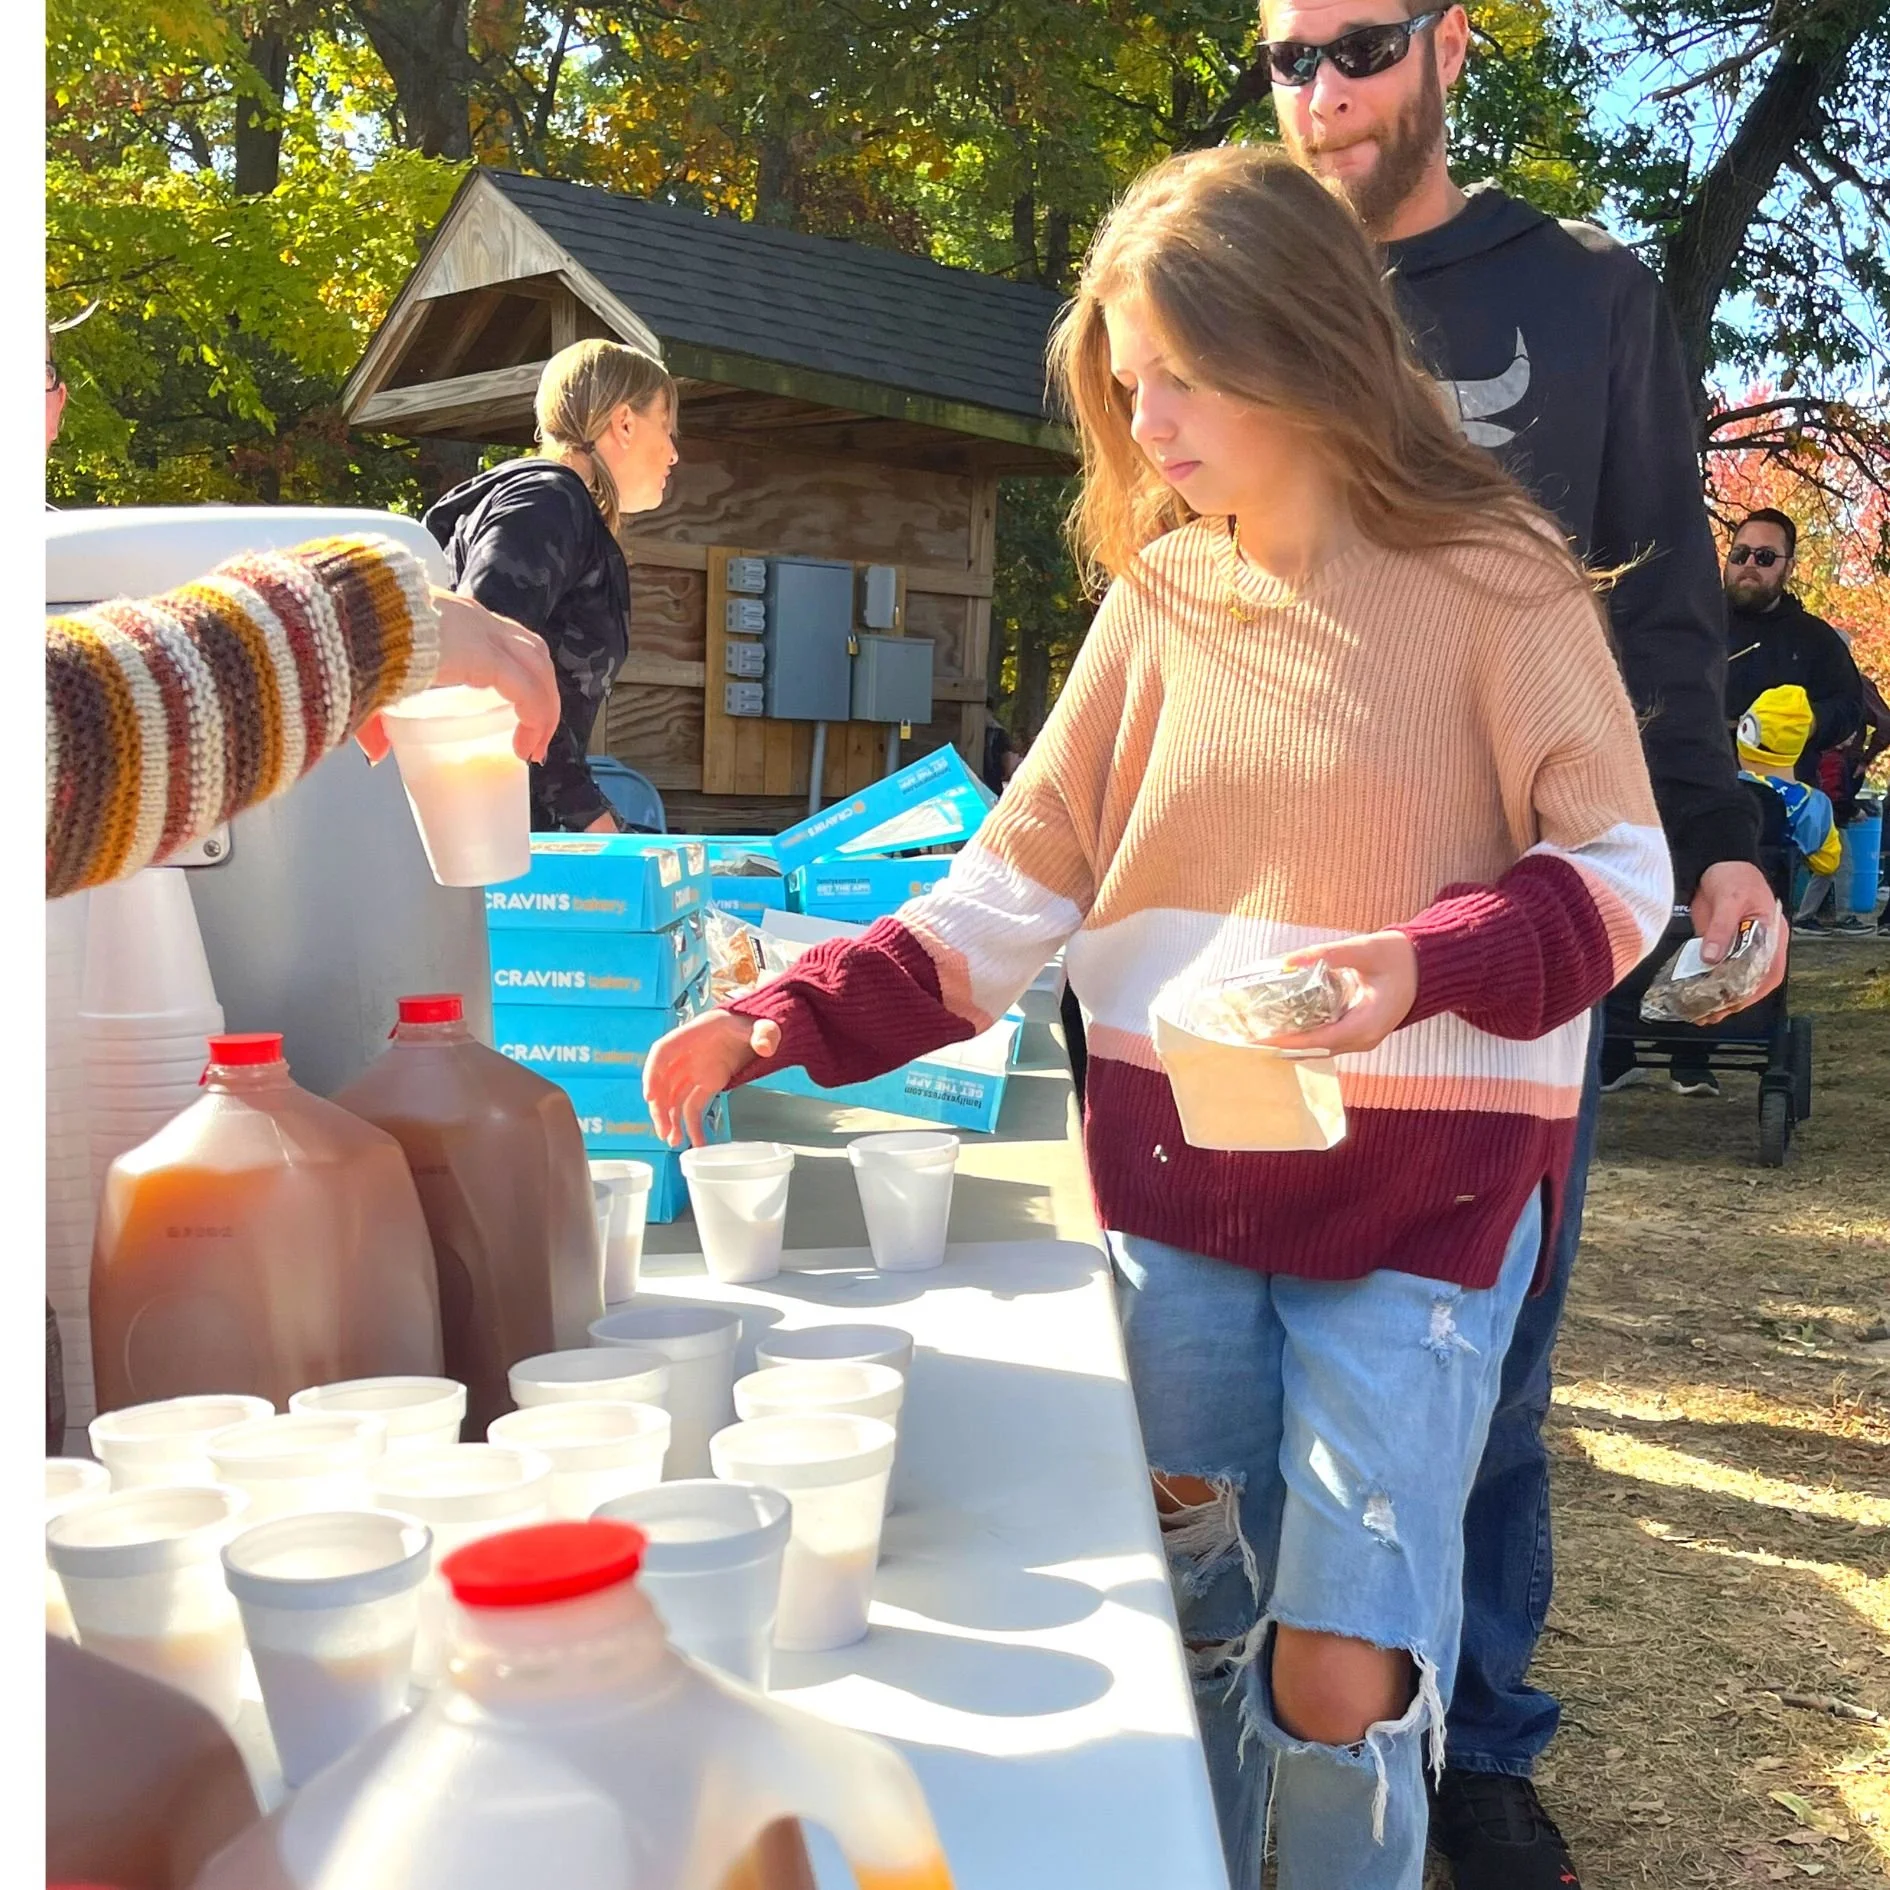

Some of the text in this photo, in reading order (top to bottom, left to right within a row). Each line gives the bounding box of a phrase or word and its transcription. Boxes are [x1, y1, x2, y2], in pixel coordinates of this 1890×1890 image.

[711, 900, 740, 910] VIN'S
[494, 969, 585, 989] CRAVIN'S
[500, 1044, 591, 1063] CRAVIN'S
[935, 1081, 958, 1094] THE
[904, 1087, 982, 1109] familyexpress.com
